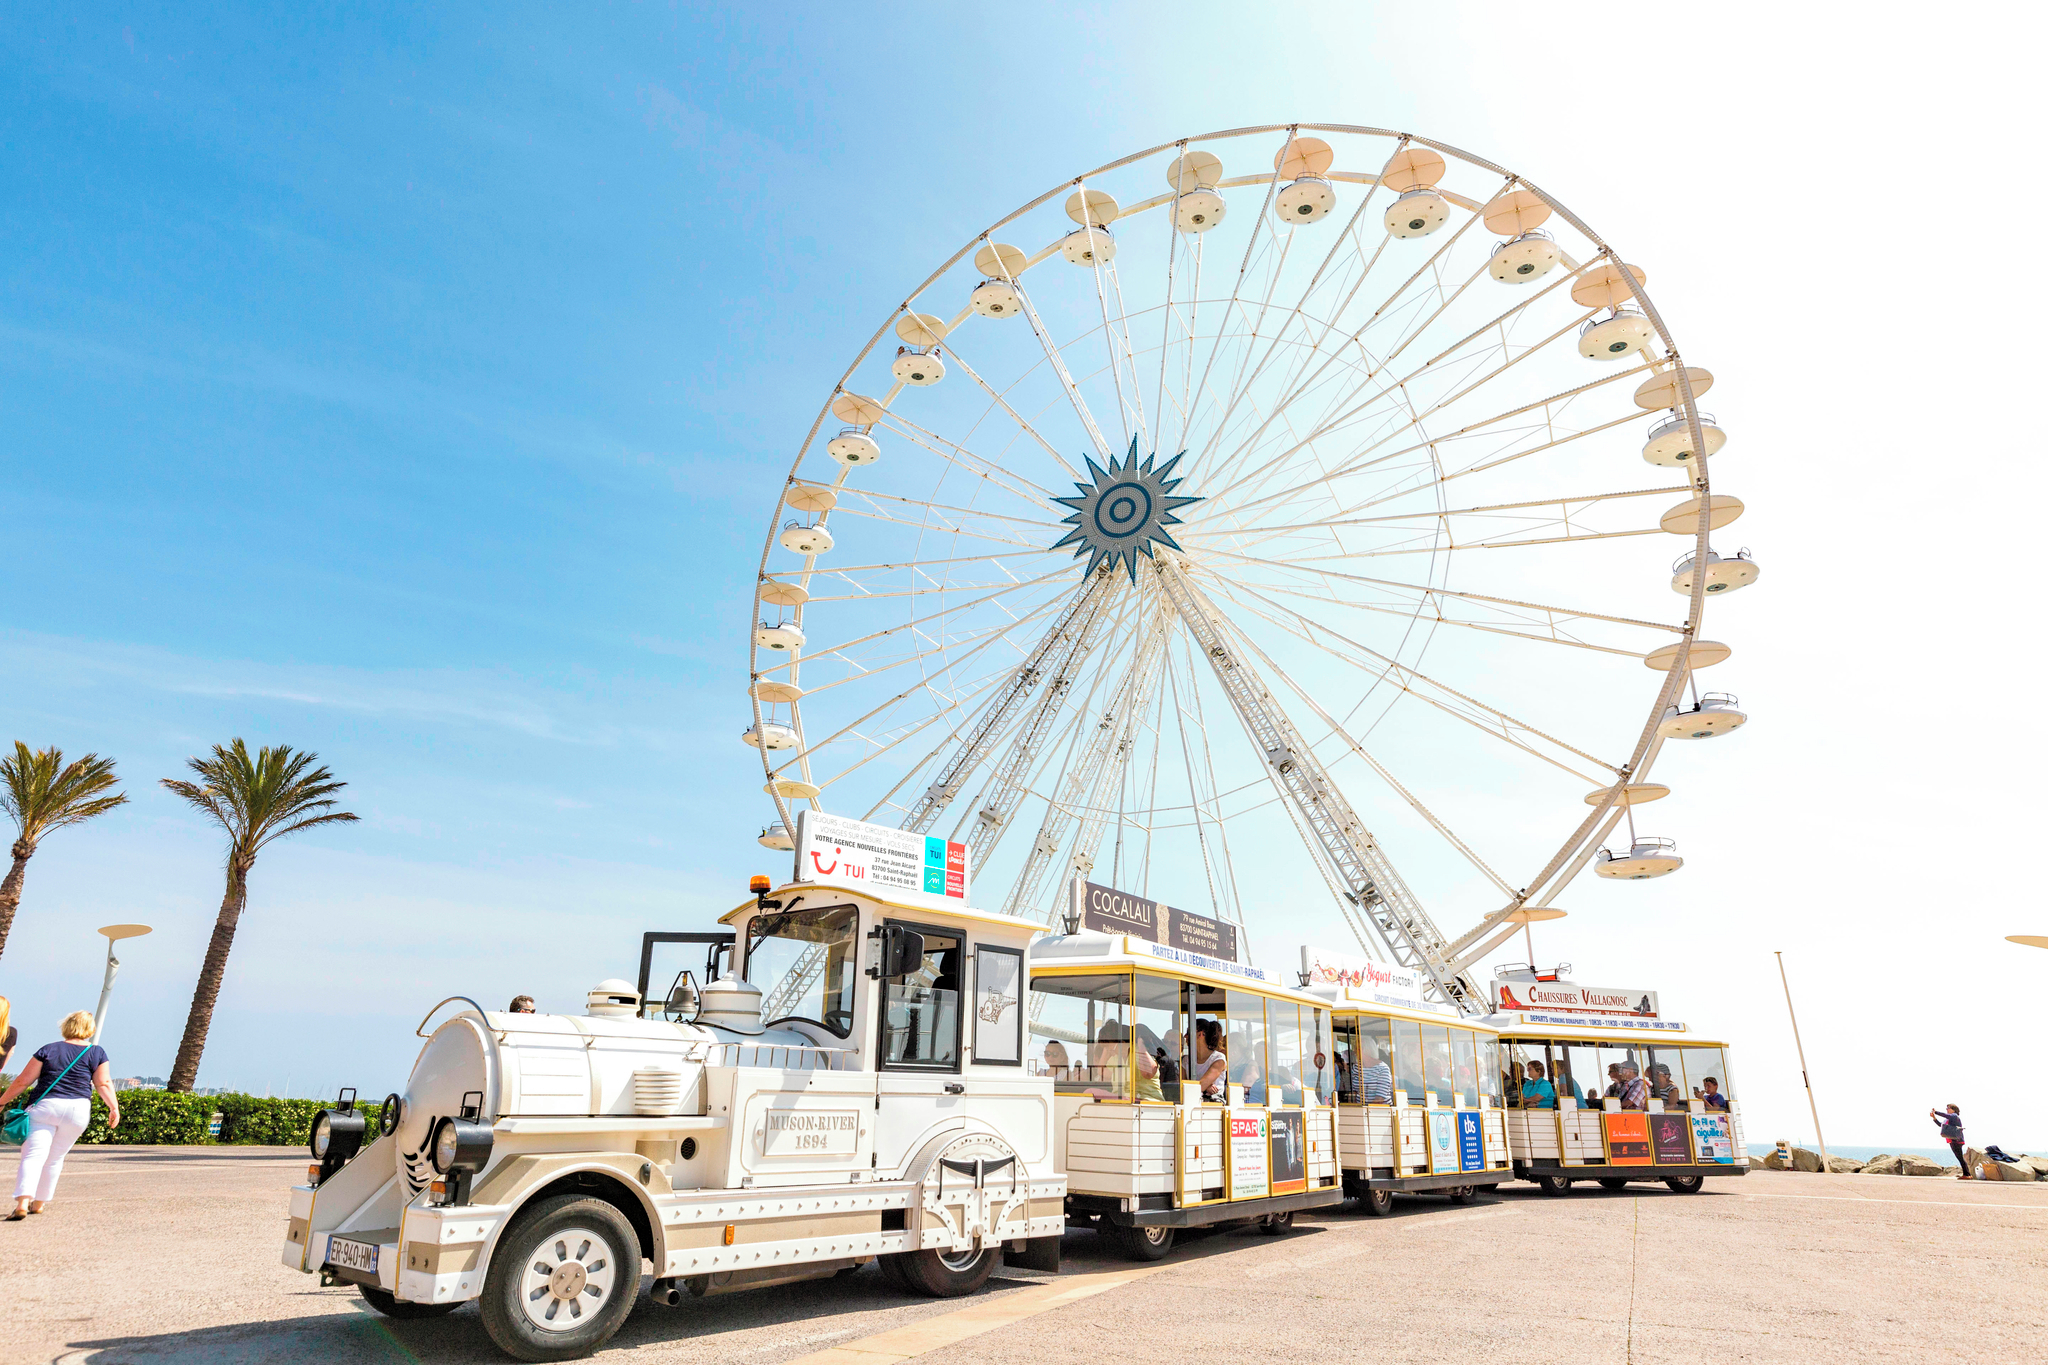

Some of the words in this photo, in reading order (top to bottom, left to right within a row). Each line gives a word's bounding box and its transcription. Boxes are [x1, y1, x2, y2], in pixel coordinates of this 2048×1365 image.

[811, 814, 838, 826] SÉJOURS
[842, 821, 860, 831] CLUBS
[864, 826, 889, 838] CIRCUITS
[815, 834, 832, 844] VOTRE
[834, 838, 856, 848] AGENCE
[856, 842, 886, 854] NOUVELLES
[820, 826, 848, 838] VOYAGES
[848, 832, 860, 840] SUR
[860, 834, 882, 844] MESURE
[887, 840, 900, 849] VOLS
[902, 843, 914, 852] SECS
[930, 850, 942, 860] TUI
[844, 864, 864, 880] TUI
[872, 864, 886, 872] 83700
[902, 862, 916, 870] Aicard
[1092, 890, 1150, 924] COCALALI
[1182, 914, 1188, 922] 79
[1180, 922, 1192, 934] 83700
[1189, 936, 1195, 945] 04
[1195, 937, 1200, 946] 94
[1200, 939, 1206, 948] 95
[1206, 940, 1212, 949] 15
[1152, 944, 1174, 960] PARTEZ
[1180, 952, 1188, 964] LA
[1222, 962, 1229, 972] DE
[1366, 962, 1392, 988] Yogurt
[1392, 974, 1414, 988] FACTORY
[1528, 986, 1578, 1004] CHAUSSURES
[1582, 988, 1628, 1006] VALLAGNOSC
[1412, 1000, 1416, 1009] DE
[1232, 1122, 1258, 1134] SPAR
[1464, 1114, 1476, 1134] tbs
[1692, 1118, 1700, 1126] De
[1709, 1120, 1717, 1128] en
[795, 1134, 828, 1149] 1894
[1696, 1127, 1723, 1143] aiguilles
[331, 1240, 372, 1269] ER-940-HM
